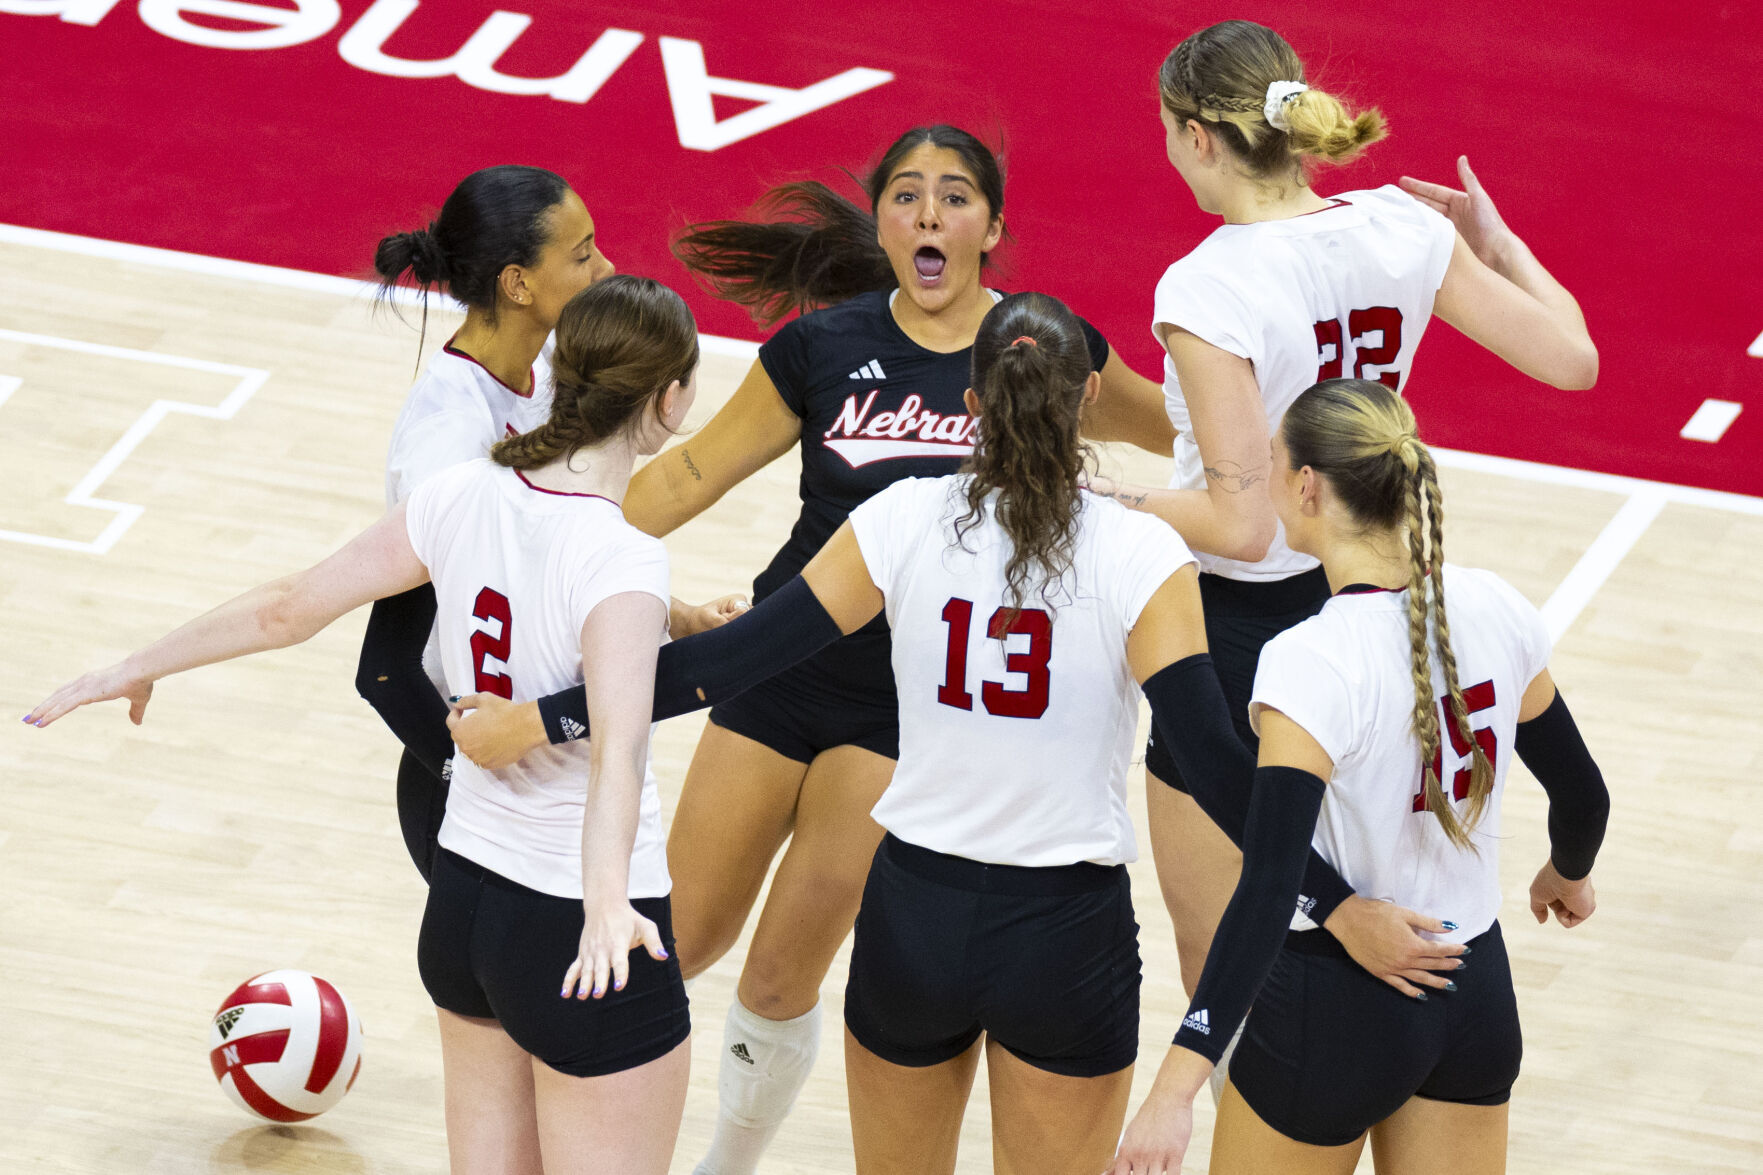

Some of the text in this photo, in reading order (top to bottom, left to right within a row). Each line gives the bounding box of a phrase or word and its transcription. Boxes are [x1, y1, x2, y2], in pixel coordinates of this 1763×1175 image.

[1312, 305, 1404, 393] 22
[469, 585, 514, 701] 2
[938, 596, 1053, 720] 13
[1412, 678, 1498, 813] 15
[222, 1043, 241, 1067] N
[1183, 1018, 1211, 1035] adidas
